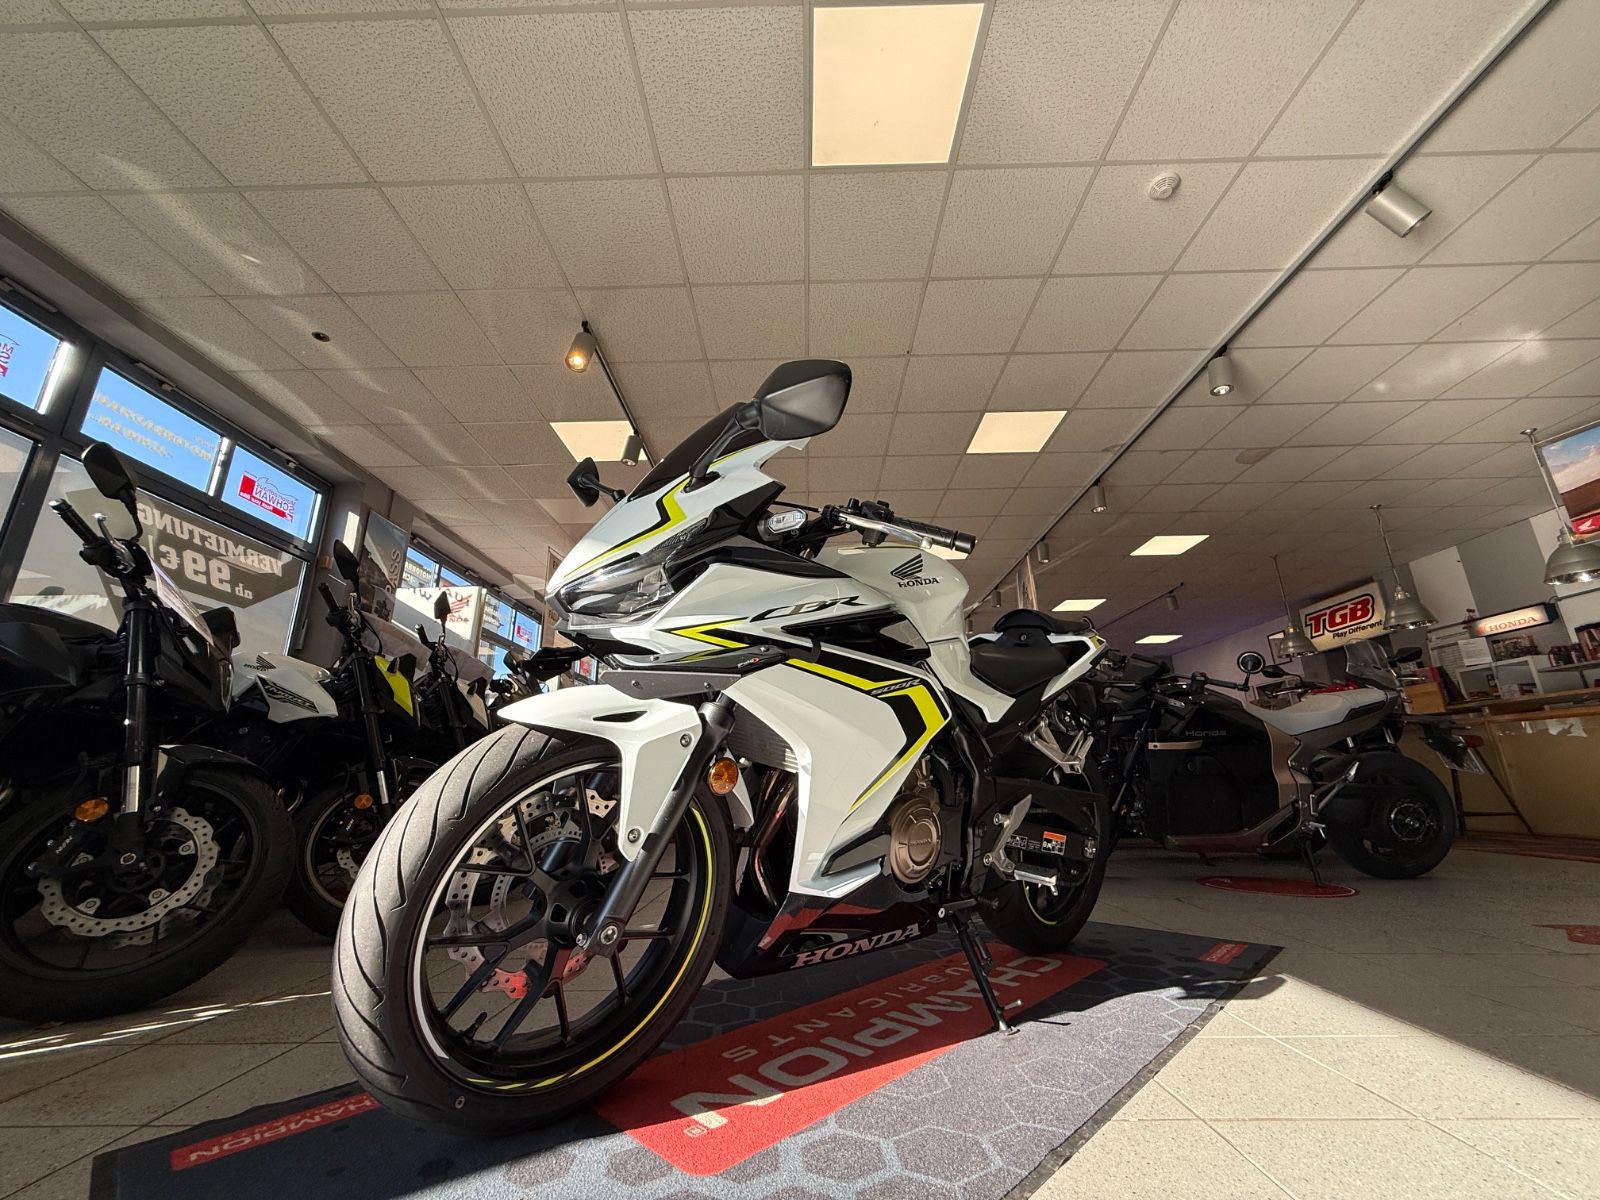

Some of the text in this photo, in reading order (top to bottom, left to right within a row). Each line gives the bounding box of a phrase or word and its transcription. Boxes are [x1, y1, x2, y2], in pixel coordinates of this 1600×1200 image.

[897, 577, 940, 588] HONDA
[749, 595, 868, 623] CBR
[1305, 594, 1375, 638] TGB
[1332, 619, 1383, 640] Play Different
[1489, 616, 1538, 632] HONDA
[870, 678, 922, 695] 500R
[790, 922, 921, 969] HONDA
[672, 957, 1063, 1129] CHAMPION
[189, 1098, 375, 1162] HAMPION
